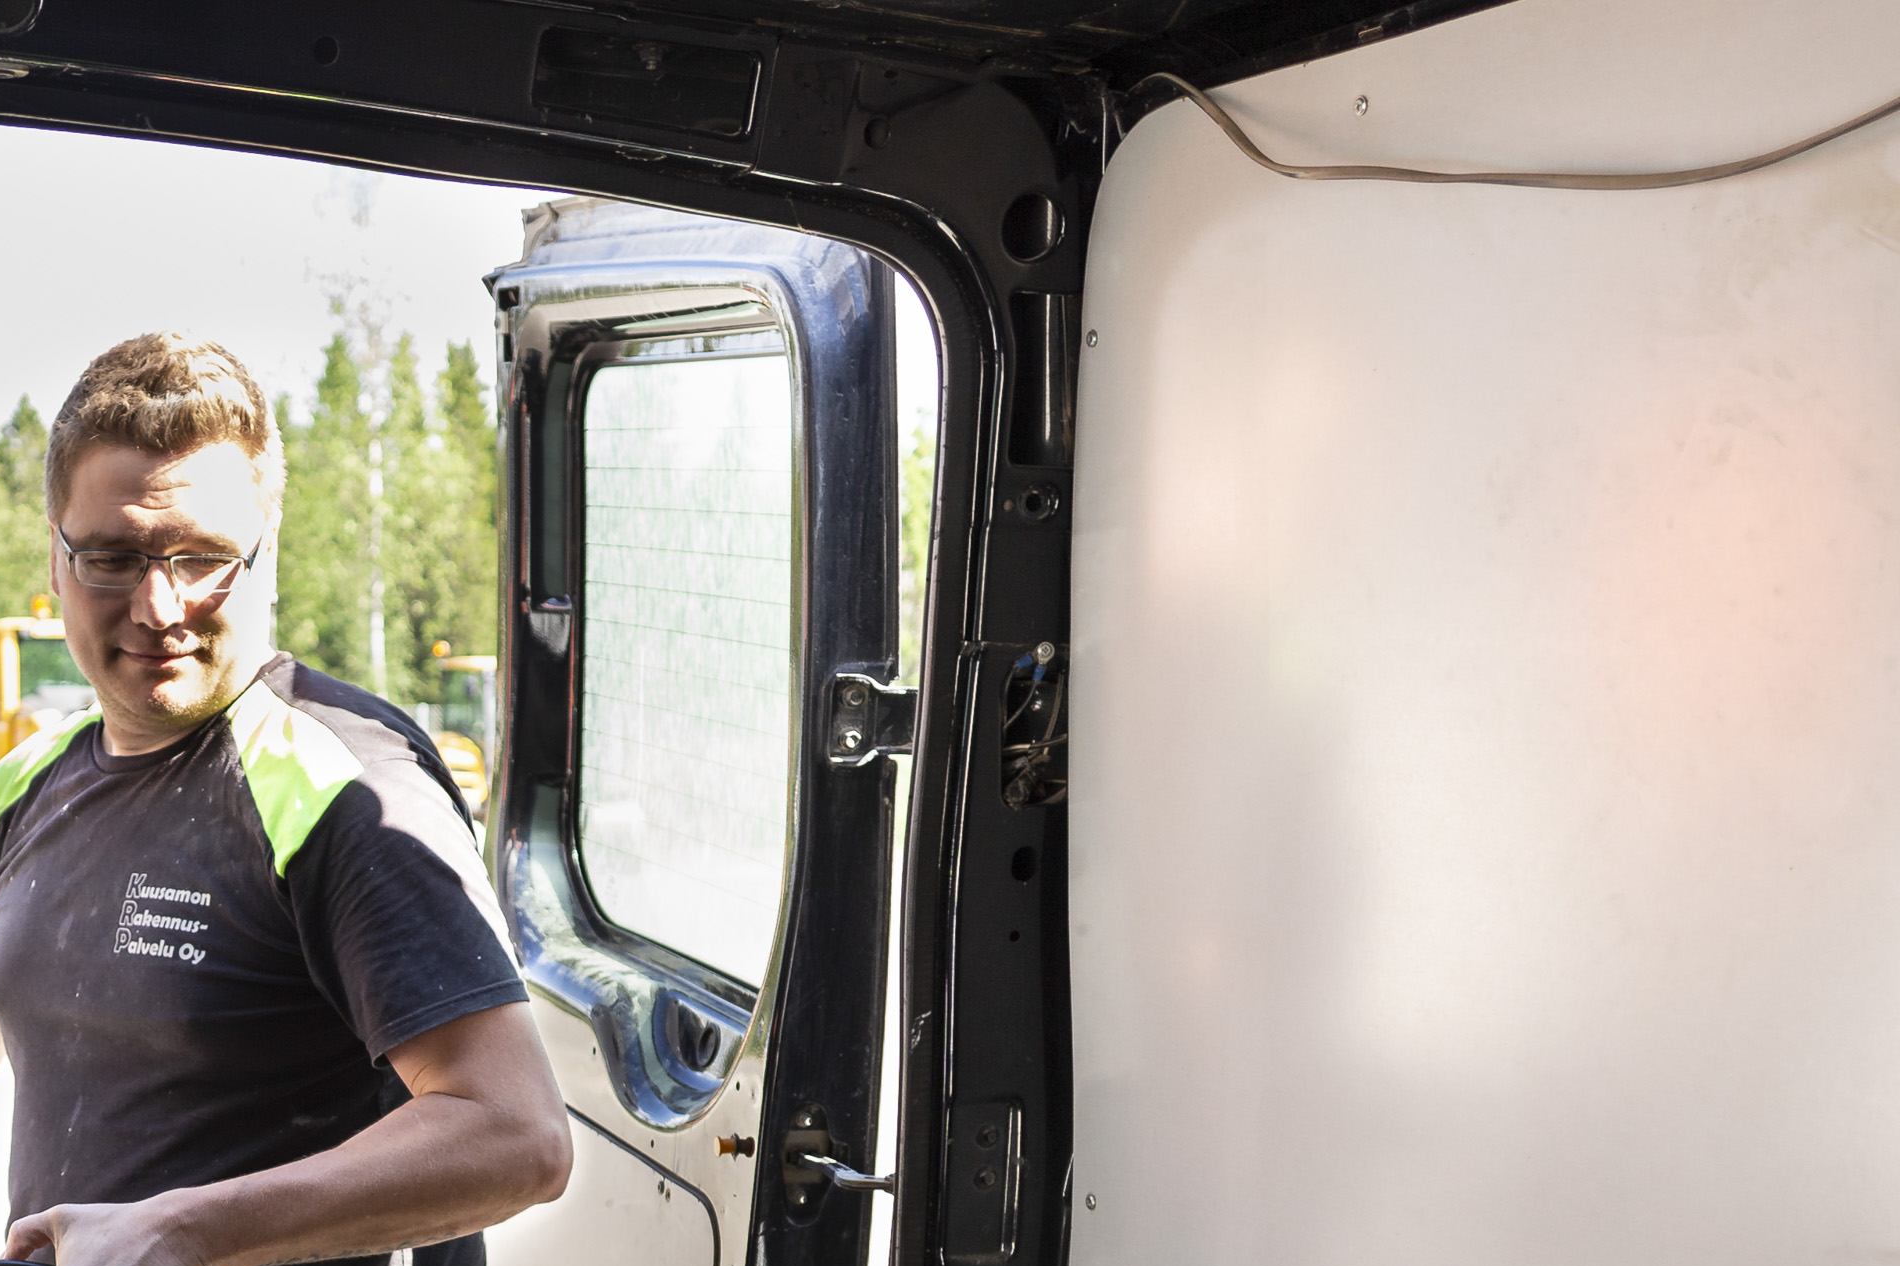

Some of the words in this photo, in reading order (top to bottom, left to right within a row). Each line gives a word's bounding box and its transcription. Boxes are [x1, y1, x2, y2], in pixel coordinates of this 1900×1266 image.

[126, 872, 211, 907] Kuusamon
[119, 899, 208, 934] Rakennus-
[114, 927, 175, 959] Palvelu
[178, 942, 206, 965] Oy
